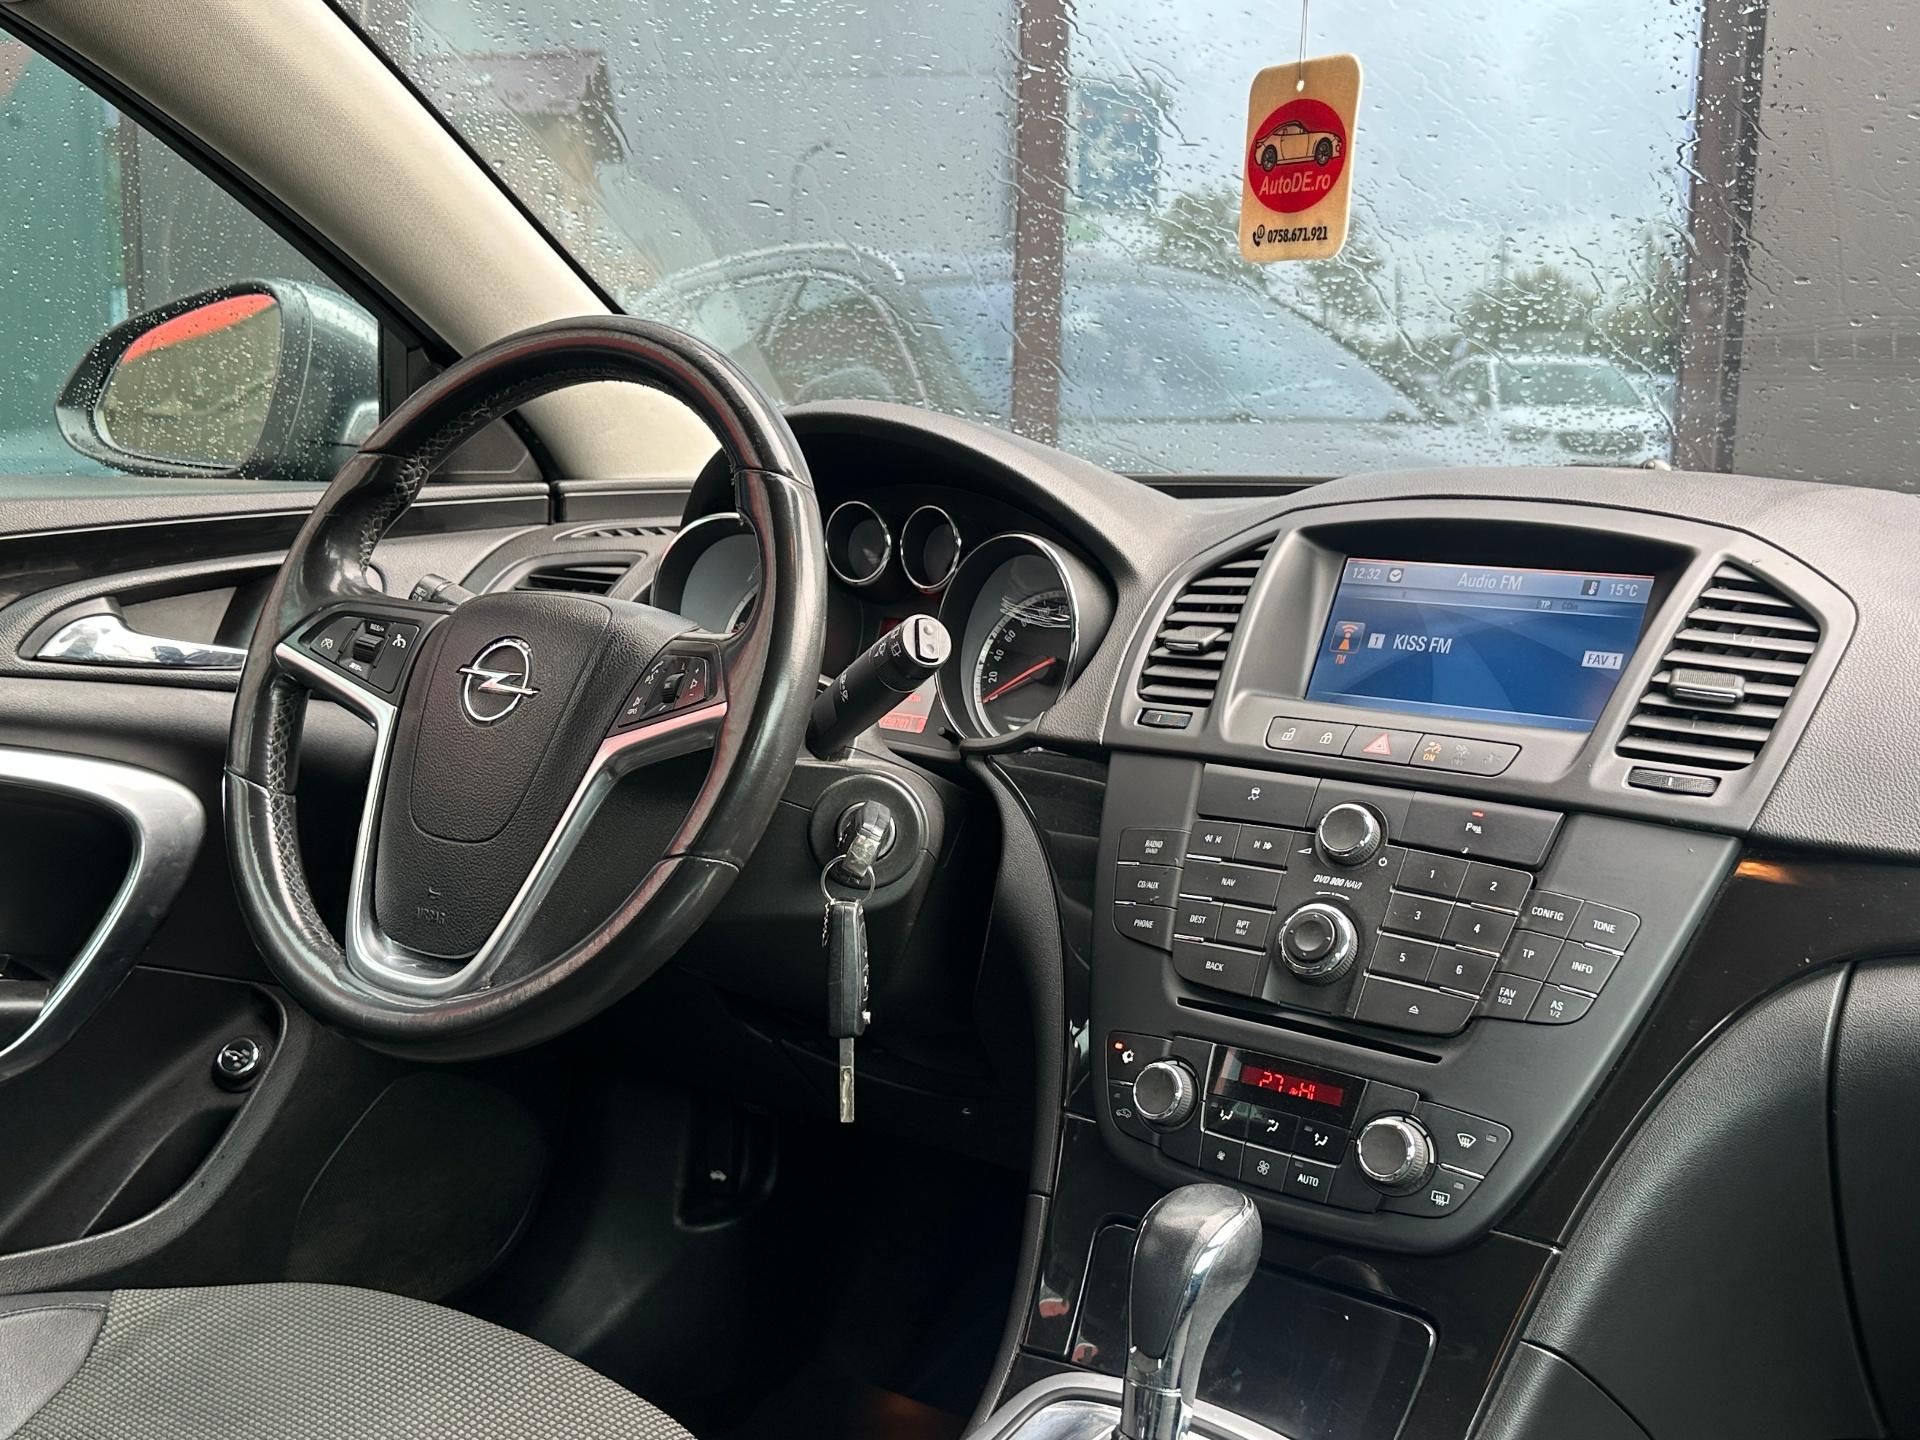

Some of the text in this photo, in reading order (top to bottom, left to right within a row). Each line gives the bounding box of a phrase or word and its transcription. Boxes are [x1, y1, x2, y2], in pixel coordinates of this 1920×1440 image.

[1259, 171, 1331, 196] AutoDE.ro
[1267, 226, 1328, 244] 0758.671.921
[1352, 567, 1381, 580] 12:32
[1457, 572, 1523, 591] Audio FM
[1609, 583, 1638, 598] 15°C
[1004, 629, 1016, 643] 60
[1392, 634, 1452, 654] KISS FM
[993, 649, 1005, 662] 40
[1335, 654, 1347, 665] FM
[1586, 653, 1618, 666] FAV 1
[988, 671, 998, 684] 20
[1144, 840, 1164, 849] RADIO
[1429, 869, 1435, 879] 1
[1221, 878, 1236, 887] NAV
[1313, 874, 1329, 885] DVD
[1344, 879, 1362, 890] NAVI
[1489, 881, 1498, 891] 2
[1189, 914, 1207, 924] DEST
[1414, 911, 1421, 920] 3
[1531, 906, 1565, 921] CONFIG
[1133, 919, 1154, 929] PHONE
[1236, 919, 1250, 928] RPT
[1473, 923, 1481, 933] 4
[1593, 919, 1617, 934] TONE
[1399, 952, 1406, 962] 5
[1522, 948, 1535, 959] TP
[1205, 960, 1224, 972] BACK
[1456, 965, 1463, 975] 6
[1571, 961, 1593, 974] INFO
[1500, 987, 1517, 998] FAV
[1550, 1000, 1564, 1011] AS
[1258, 1071, 1285, 1093] 27
[1297, 1173, 1320, 1187] AUTO
